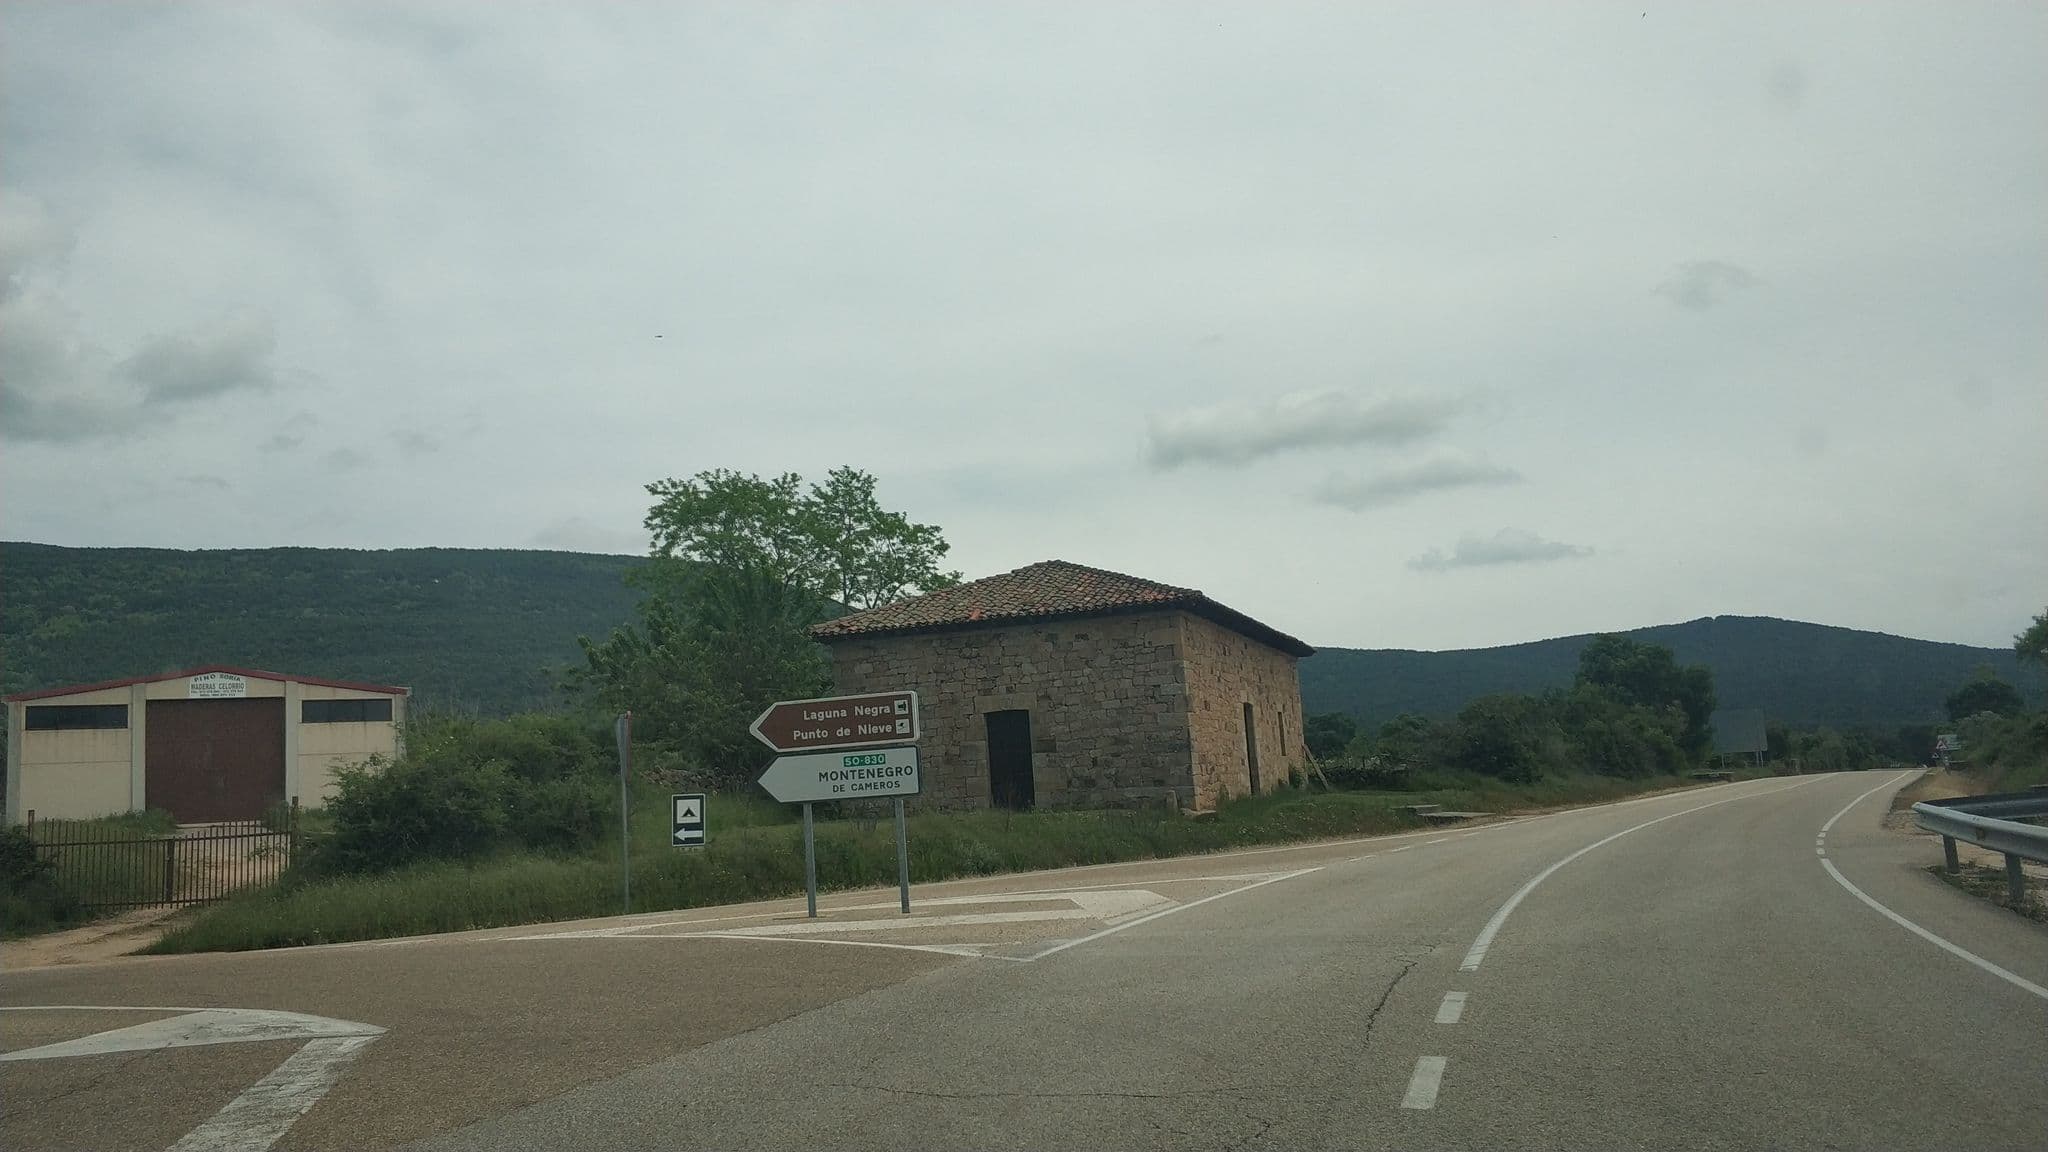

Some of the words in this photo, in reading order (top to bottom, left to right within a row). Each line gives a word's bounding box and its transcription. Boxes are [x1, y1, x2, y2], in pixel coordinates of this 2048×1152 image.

[803, 709, 847, 721] Laguna
[854, 704, 891, 717] Negra
[793, 728, 829, 741] Punto
[836, 726, 851, 737] de
[858, 724, 893, 736] Nieve
[845, 756, 885, 766] SO-830
[819, 766, 913, 782] MONTENEGRO
[832, 784, 846, 793] DE
[851, 781, 900, 791] CAMEROS
